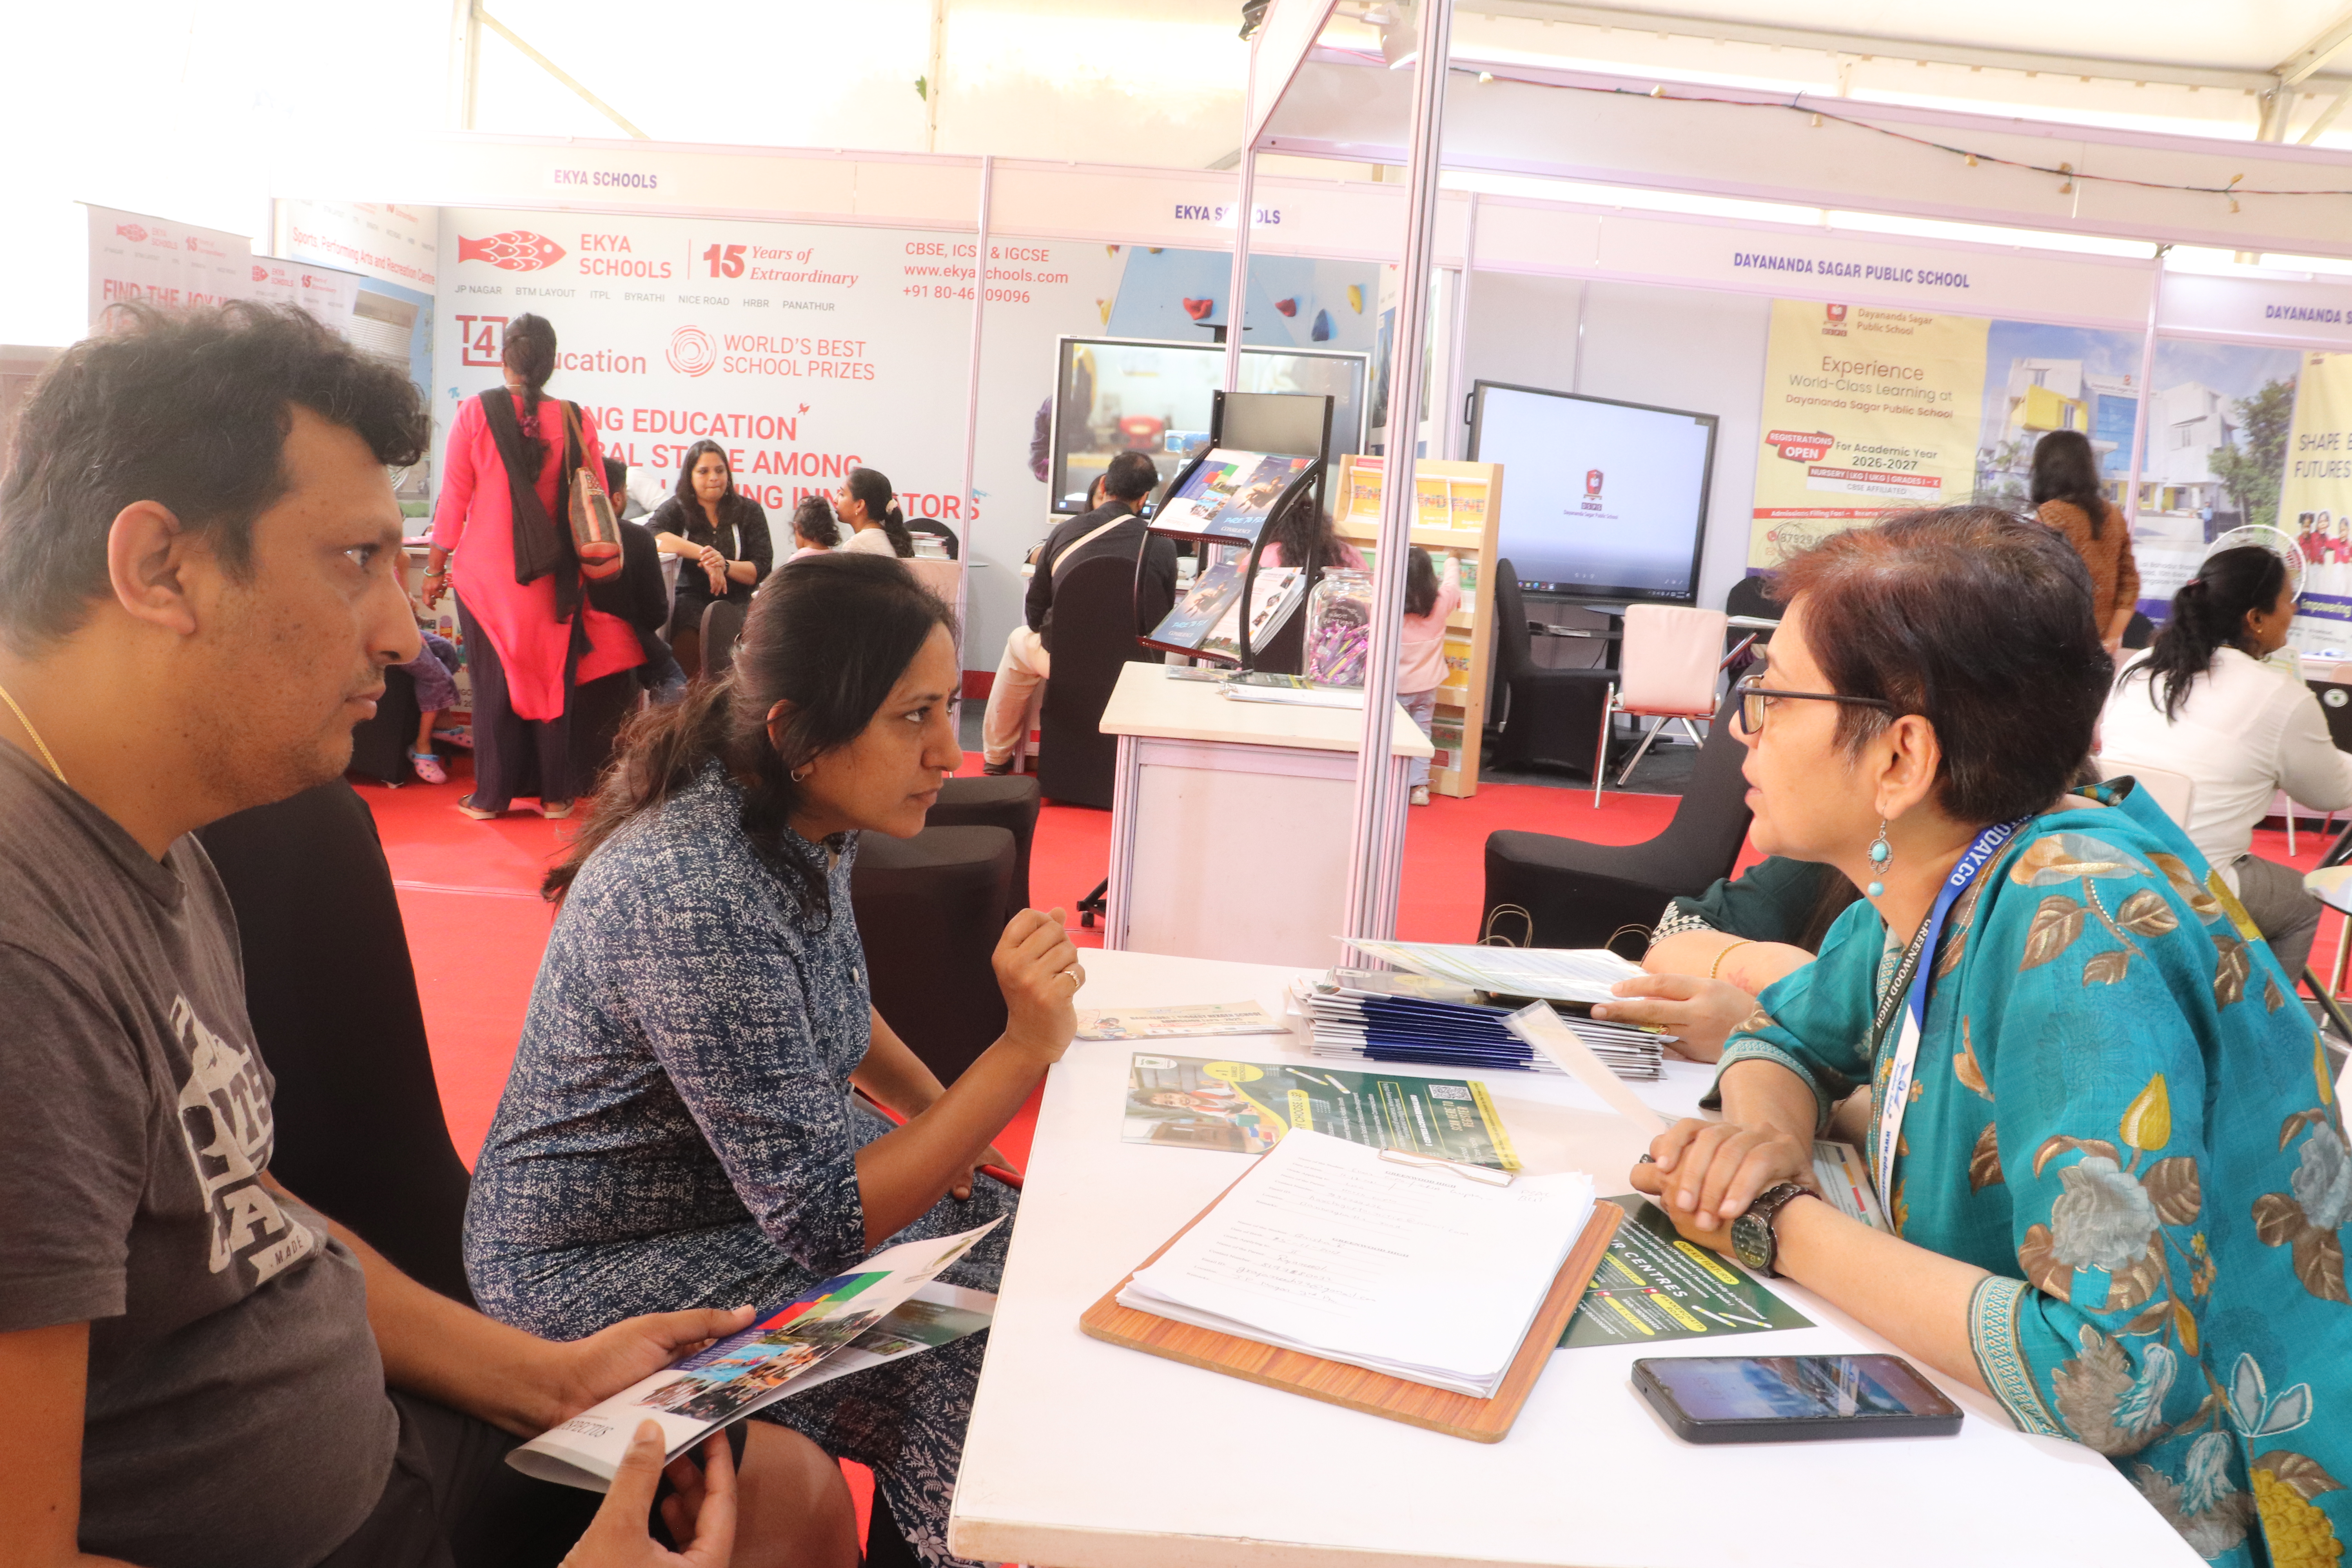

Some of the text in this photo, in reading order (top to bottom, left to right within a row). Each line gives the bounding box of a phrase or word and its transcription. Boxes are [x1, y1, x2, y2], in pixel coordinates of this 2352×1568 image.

[554, 169, 658, 189] EKYA SCHOOLS
[1176, 205, 1281, 225] EKYA SOLS
[151, 238, 178, 250] SCHOOLS
[185, 236, 198, 251] 15
[580, 234, 632, 253] EKYA
[906, 242, 1050, 262] CBSE, ICS & IGCSE
[293, 226, 435, 285] Sports, Performing Arts and Recreation Centre
[703, 243, 747, 278] 15
[752, 245, 814, 265] Years of
[579, 258, 671, 278] SCHOOLS
[750, 266, 858, 288] Extraordinary
[904, 264, 1069, 285] www.ekyachools.com
[1734, 252, 1970, 288] DAYANANDA SAGAR PUBLIC SCHOOL
[270, 277, 294, 287] SCHOOLS
[301, 274, 312, 288] 15
[455, 285, 503, 295] JP NAGAR
[103, 278, 142, 301] FIND
[146, 285, 180, 306] THE
[188, 291, 214, 306] JOY
[515, 287, 576, 298] BTM LAYOUT
[590, 291, 611, 300] ITPL
[624, 292, 665, 303] BYRATHI
[678, 295, 730, 307] NICE ROAD
[903, 285, 1031, 303] +91 80-4609096
[743, 299, 769, 308] HRBR
[782, 300, 835, 312] PANATHUR
[1858, 309, 1933, 326] Dayananda Sagar
[2265, 304, 2342, 324] DAYANANDA
[1857, 322, 1914, 336] Public School
[817, 339, 866, 358] BEST
[554, 349, 646, 374] cation
[723, 356, 875, 381] SCHOOL PRIZES
[1822, 356, 1924, 381] Experience
[1789, 374, 1953, 404] World-Class Learning at
[1786, 394, 1953, 419] Dayananda Sagar Public School
[633, 408, 797, 441] EDUCATION
[1770, 433, 1833, 446] REGISTRATIONS
[2299, 433, 2340, 452] SHAPE
[1785, 446, 1819, 459] OPEN
[1836, 441, 1938, 459] For Academic Year
[651, 444, 862, 478] STE AMONG
[1852, 456, 1918, 471] 2026-2027
[2294, 460, 2351, 478] FUTURES
[1811, 468, 1921, 485] NURSERY LKG UKG GRADES
[1866, 485, 1907, 495] AFFILIATED
[1875, 918, 1932, 1029] GREENWOOD HIGH
[1291, 1092, 1303, 1102] US?
[1352, 1092, 1362, 1109] Development
[1367, 1093, 1379, 1114] Communication
[1293, 1102, 1305, 1122] CHOOSE
[1409, 1094, 1432, 1143] CENTRES ACROSS BENGALURU
[1445, 1107, 1458, 1117] HERE
[1457, 1106, 1475, 1128] REGISTER
[1448, 1118, 1463, 1132] SCAN
[1385, 1171, 1436, 1185] GREENWOOD
[274, 1235, 305, 1267] MADE
[1241, 1238, 1263, 1247] Applying
[1332, 1238, 1386, 1252] GREENWOOD
[1606, 1254, 1640, 1281] WHITEFIELD
[1627, 1234, 1645, 1249] Campus
[1645, 1248, 1665, 1264] Digitally
[1661, 1261, 1685, 1280] Equipped
[1682, 1277, 1710, 1299] Classrooms
[1653, 1235, 1666, 1246] Ratio
[1666, 1245, 1701, 1270] CCTV-Secured
[1696, 1266, 1716, 1283] Campus
[1678, 1242, 1734, 1283] OUR KEY FEATURES
[1186, 1272, 1210, 1281] Remarks
[1624, 1252, 1689, 1298] CENTRES
[1657, 1247, 1677, 1263] Tracking
[1673, 1261, 1693, 1275] System
[1692, 1275, 1717, 1295] Nutritious
[1715, 1292, 1731, 1305] Meals
[1618, 1307, 1642, 1325] E-CITY
[1666, 1306, 1684, 1320] ROAD
